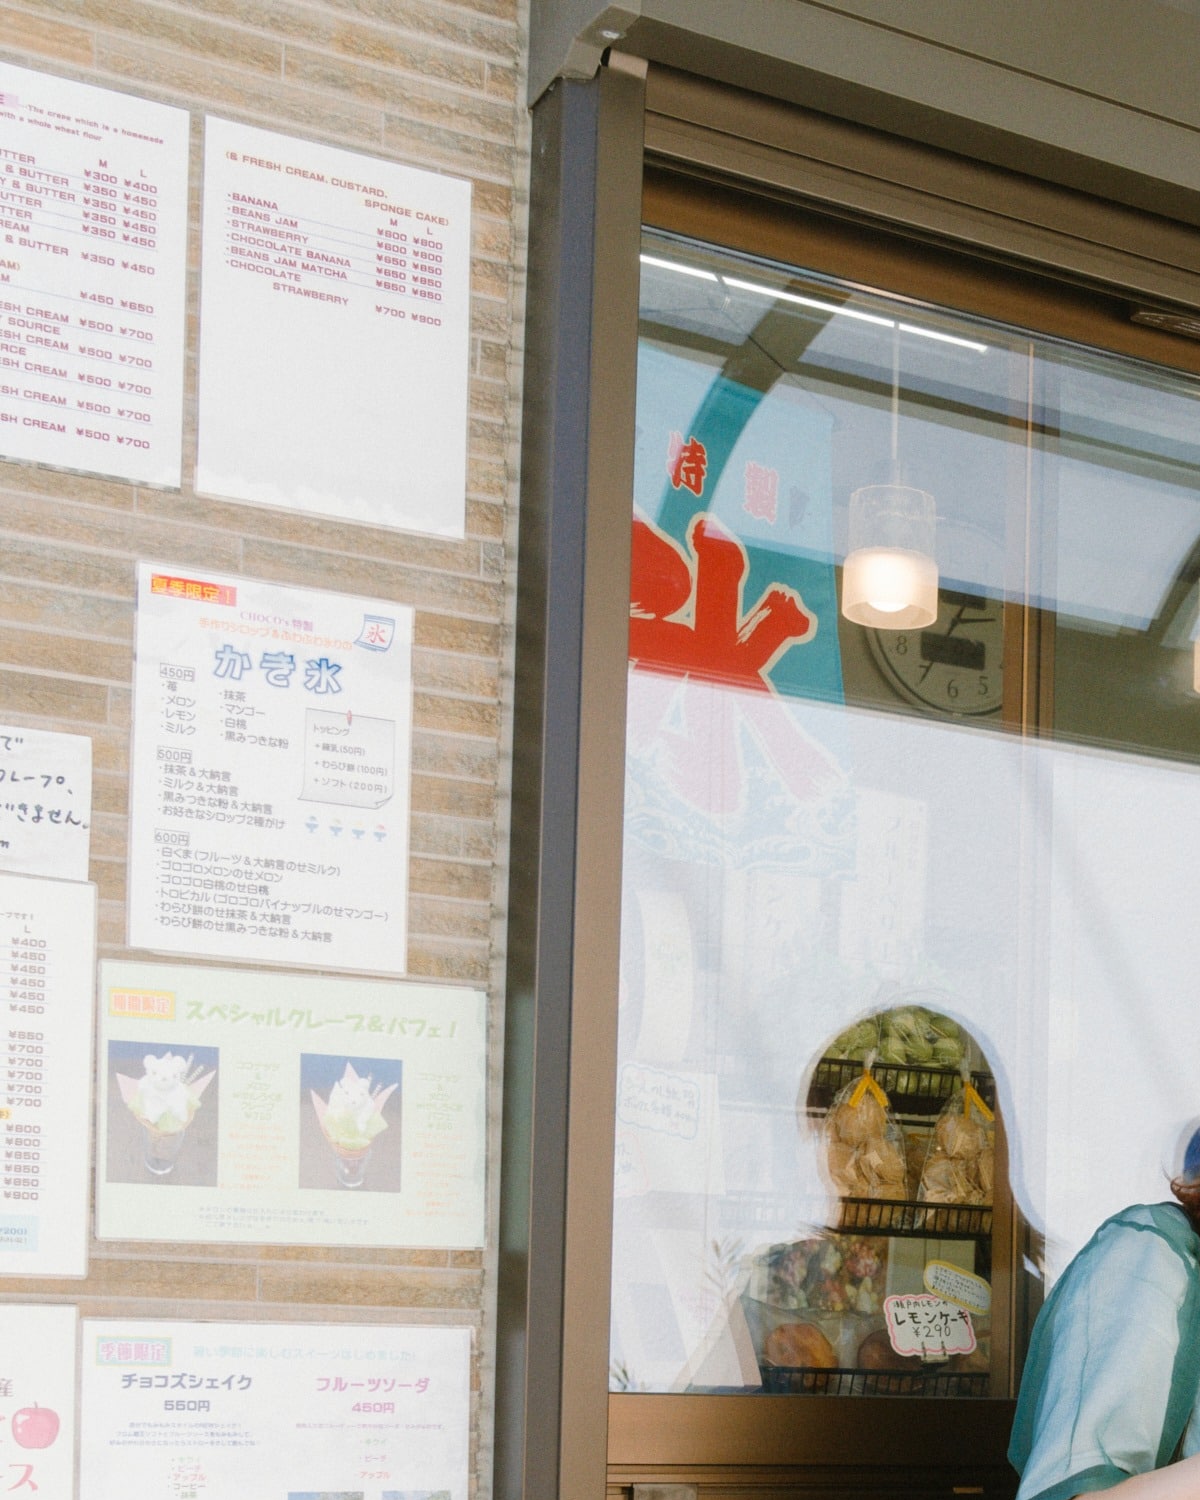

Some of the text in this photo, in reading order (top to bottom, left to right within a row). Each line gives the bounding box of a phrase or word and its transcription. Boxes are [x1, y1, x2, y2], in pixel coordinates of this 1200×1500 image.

[54, 125, 79, 135] wheat
[98, 158, 147, 178] M L
[242, 154, 281, 171] FRESH
[18, 166, 68, 186] BUTTER
[83, 182, 117, 197] ¥350
[123, 192, 156, 207] ¥450
[83, 168, 157, 193] ¥300 ¥400
[25, 182, 75, 202] BUTTER
[82, 196, 116, 211] ¥350
[122, 205, 156, 221] ¥450
[364, 198, 448, 226] SPONGE CAKE)
[82, 210, 156, 234] ¥350 ¥450
[274, 217, 298, 228] JAM
[389, 217, 433, 235] M L
[82, 224, 155, 247] ¥350 ¥450
[18, 236, 68, 256] BUTTER
[80, 251, 115, 266] ¥350
[121, 260, 154, 275] ¥450
[306, 249, 351, 267] BANANA
[273, 256, 296, 267] JAM
[301, 261, 347, 279] MATCHA
[79, 290, 113, 305] ¥450
[272, 281, 348, 305] STRAWBERRY
[375, 304, 405, 318] ¥700
[7, 316, 60, 335] SOURCE
[25, 306, 153, 341] CREAM ¥500 ¥700
[25, 334, 152, 368] CREAM ¥500 ¥700
[24, 361, 151, 395] CREAM ¥500 ¥700
[23, 389, 150, 422] CREAM ¥500 ¥700
[22, 417, 150, 449] CREAM ¥500 ¥700
[367, 623, 387, 645] 氷
[895, 634, 908, 656] 8
[159, 666, 195, 682] 450円
[211, 643, 344, 696] かき氷
[946, 678, 959, 699] 6
[977, 675, 989, 695] 5
[223, 689, 245, 702] 抹茶
[224, 703, 265, 716] マンゴー
[224, 717, 247, 730] 白桃
[313, 723, 350, 736] トッピング
[156, 748, 192, 764] 500円
[154, 831, 189, 846] 600円
[23, 924, 31, 934] L
[11, 936, 46, 948] ¥400
[10, 950, 46, 961] ¥450
[10, 963, 45, 974] ¥450
[9, 976, 45, 988] ¥450
[9, 990, 44, 1001] ¥450
[9, 1003, 44, 1014] ¥450
[7, 1043, 43, 1054] ¥700
[7, 1056, 43, 1067] ¥700
[7, 1070, 42, 1080] ¥700
[6, 1083, 42, 1094] ¥700
[6, 1096, 42, 1107] ¥700
[894, 1309, 969, 1326] レモンケーキ
[911, 1324, 952, 1338] ¥290
[121, 1372, 252, 1390] チョコズシェイク
[316, 1376, 430, 1394] フルーツソーダ
[163, 1399, 210, 1412] 550円
[351, 1401, 395, 1414] 450円
